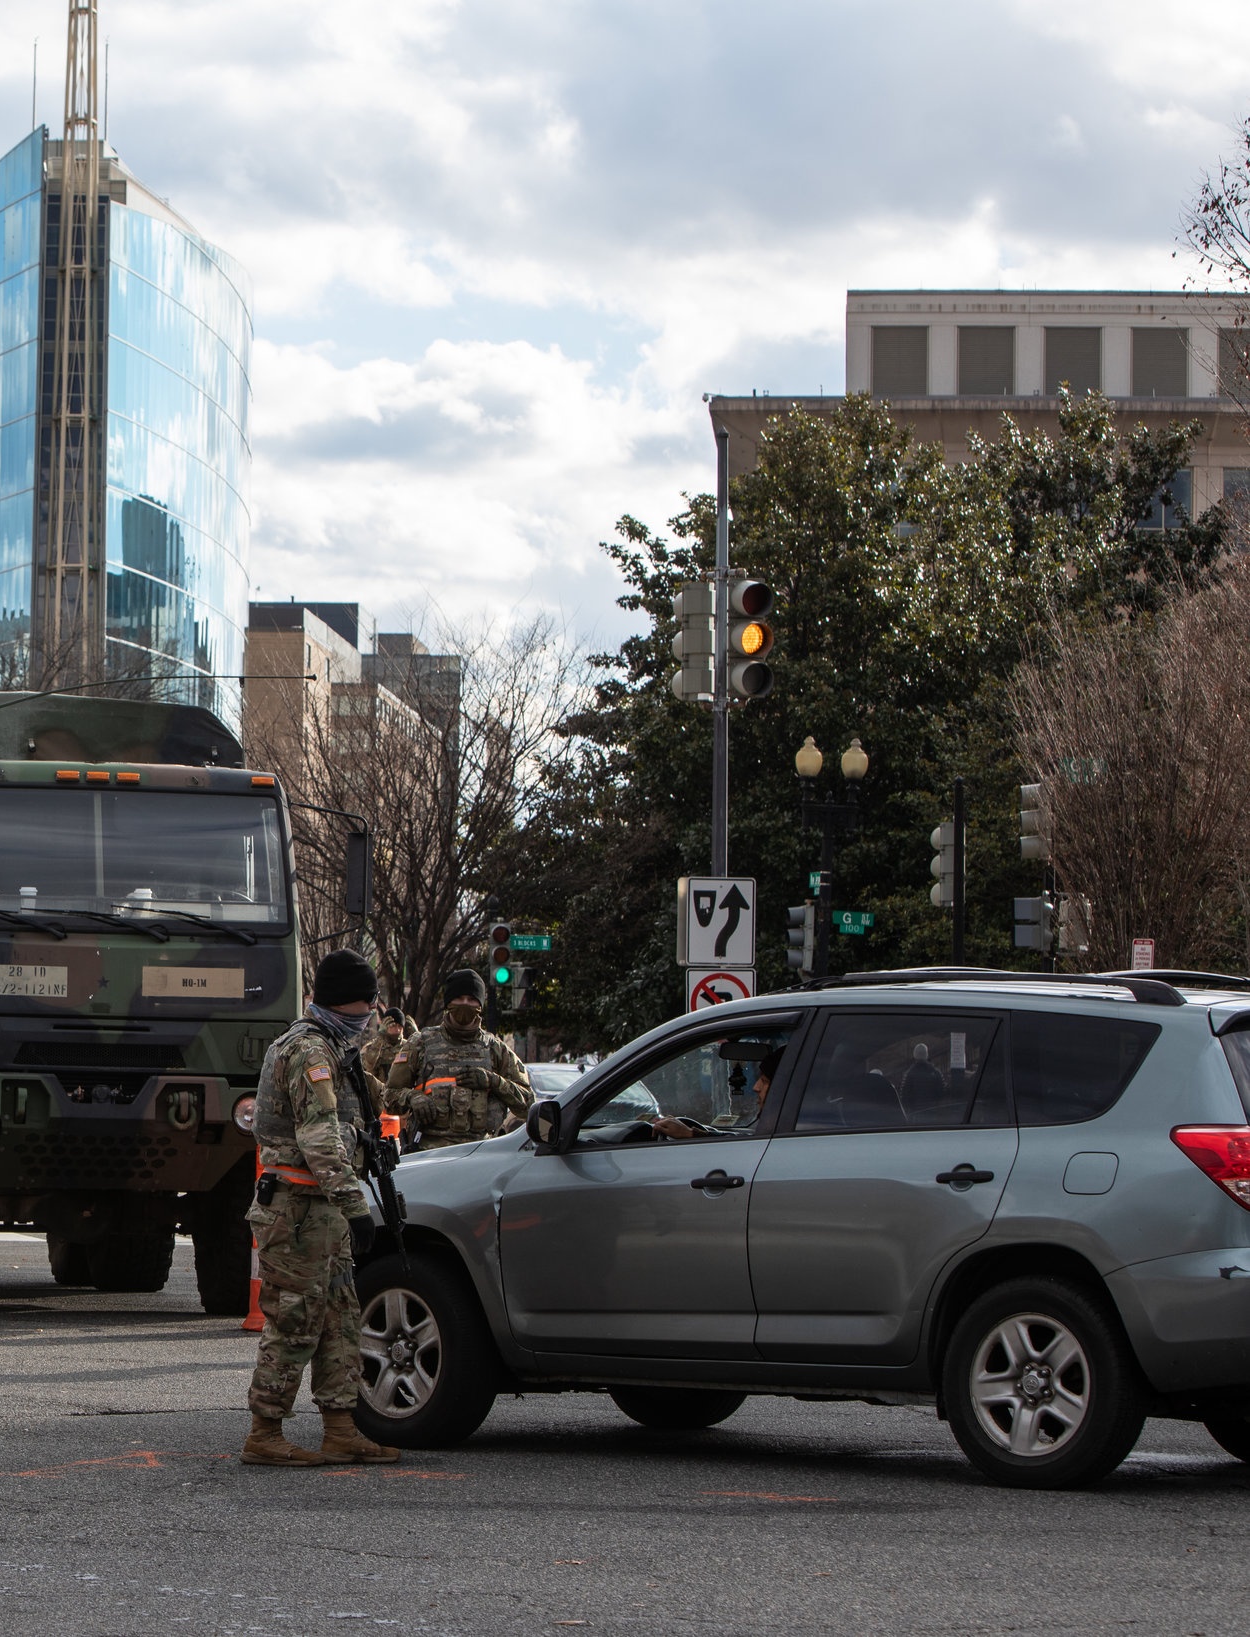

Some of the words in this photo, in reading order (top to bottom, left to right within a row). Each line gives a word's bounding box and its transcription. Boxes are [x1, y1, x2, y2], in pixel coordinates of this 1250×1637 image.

[842, 912, 852, 924] G
[845, 924, 860, 932] 100
[9, 966, 23, 977] 28
